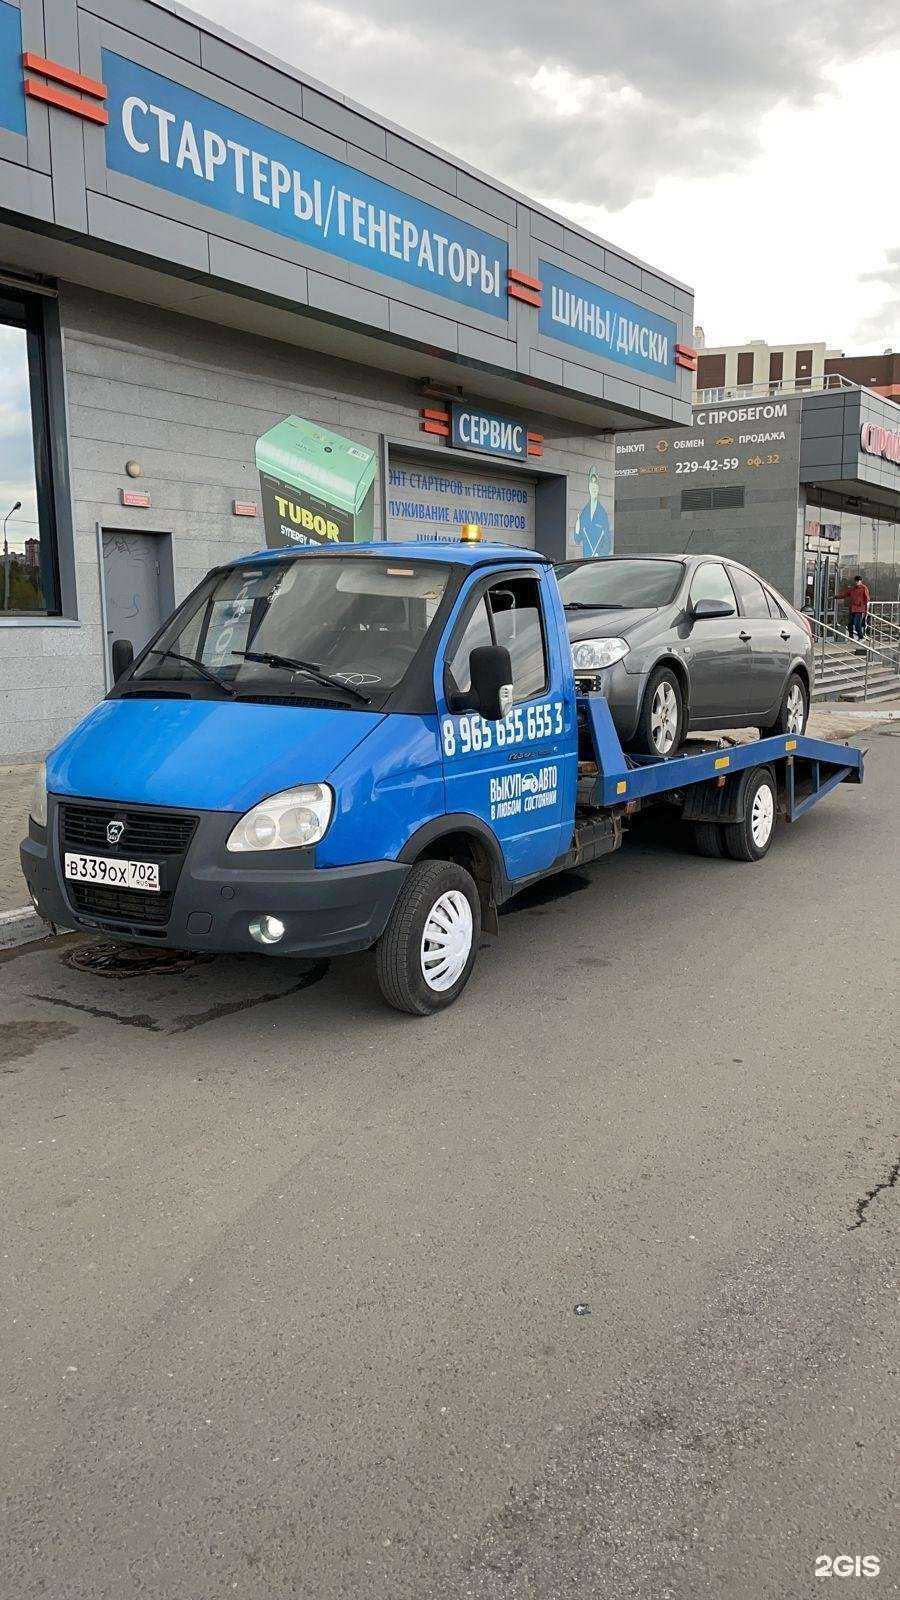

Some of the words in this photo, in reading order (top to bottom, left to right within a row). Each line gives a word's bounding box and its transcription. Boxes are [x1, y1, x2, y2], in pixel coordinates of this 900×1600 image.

[121, 96, 500, 298] СТАРТЕРЫ/ГЕНЕРАТОРЫ
[551, 286, 668, 366] ШИНЫ/ДИСКИ
[696, 413, 705, 426] С
[708, 404, 788, 425] ПРОБЕГОМ
[459, 413, 523, 453] СЕРВИС
[616, 444, 645, 454] ВЫКУП
[673, 438, 705, 450] ОБМЕН
[739, 431, 786, 444] ПРОДАЖА
[675, 457, 739, 474] 229-42-59
[766, 454, 780, 465] 32
[409, 473, 462, 496] СТАРТЕРОВ
[472, 483, 528, 504] ГЕНЕРАТОРОВ
[274, 495, 339, 543] TUBOR
[453, 509, 526, 530] АККУМУЛЯТОРОВ
[443, 720, 455, 757] 8
[460, 713, 492, 753] 965
[496, 709, 524, 746] 655
[490, 773, 521, 803] ВЫКУП
[538, 765, 558, 792] АВТО
[497, 799, 521, 819] ЛЮБОМ
[130, 863, 155, 881] 702
[136, 879, 149, 887] RUS
